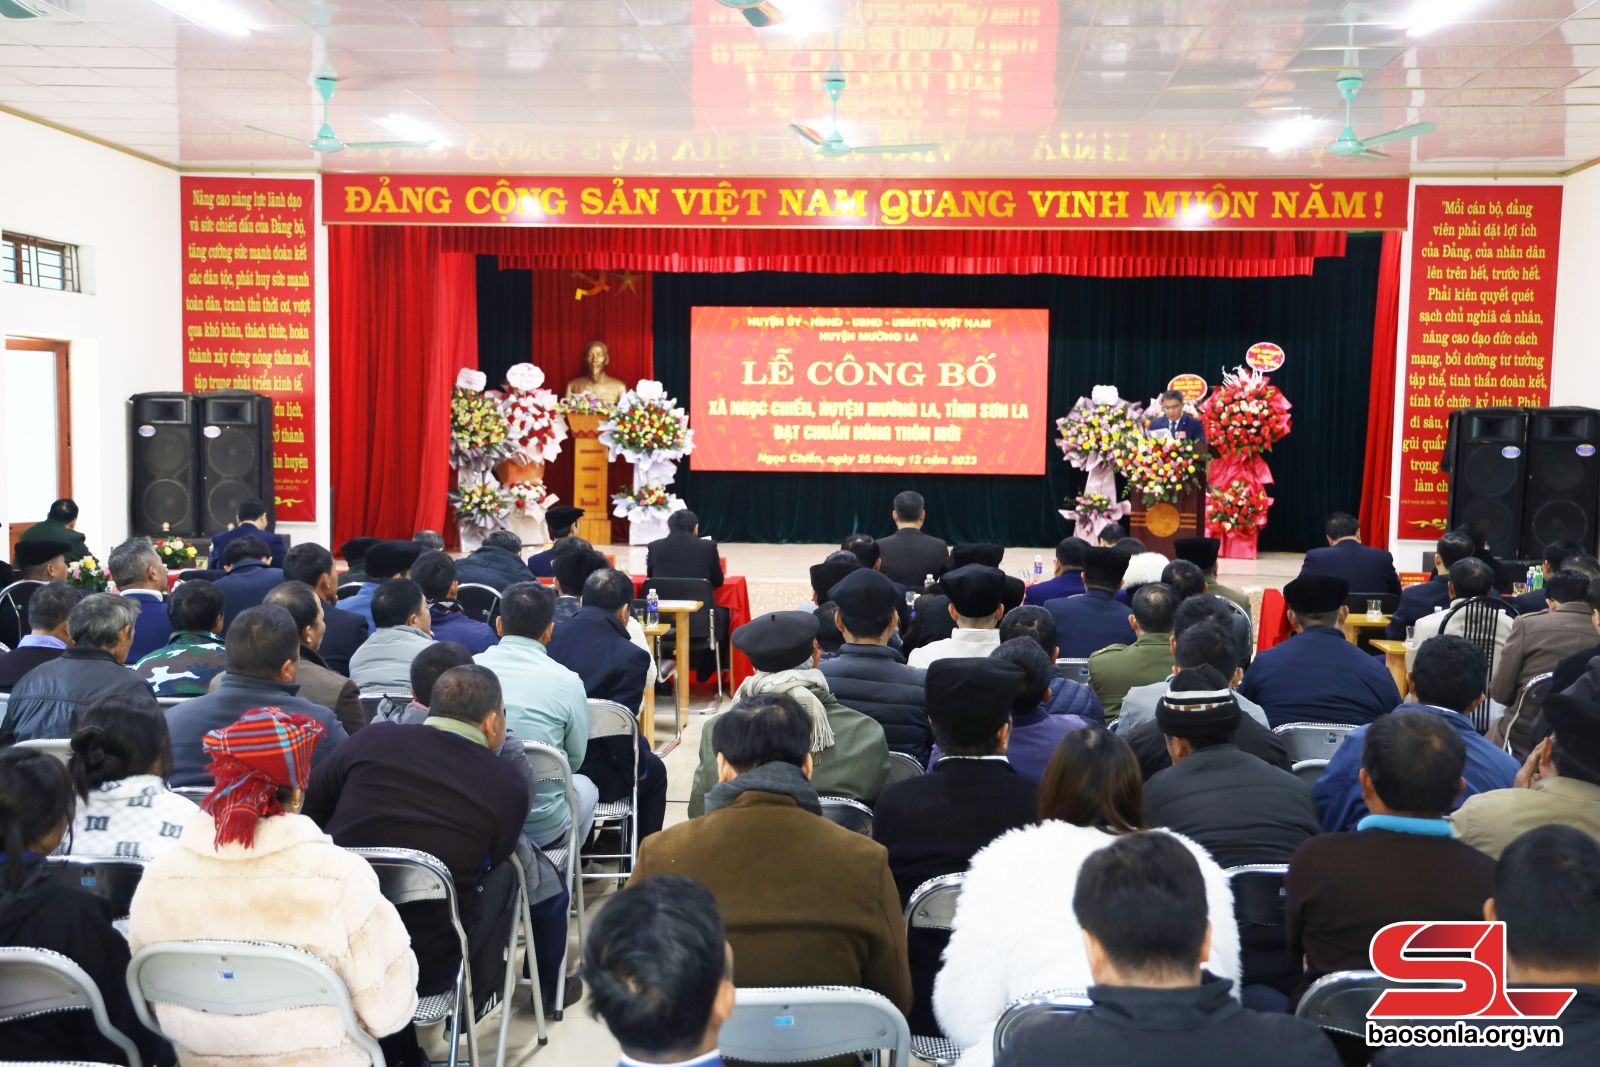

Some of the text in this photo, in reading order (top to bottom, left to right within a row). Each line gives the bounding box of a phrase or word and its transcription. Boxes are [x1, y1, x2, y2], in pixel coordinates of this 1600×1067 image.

[345, 176, 452, 213] ĐẢNG
[466, 180, 568, 223] CỘNG
[581, 176, 661, 215] SẢN
[671, 181, 767, 222] VIỆT
[779, 189, 869, 217] NAM
[879, 188, 1015, 225] QUANG
[1028, 191, 1129, 218] VINH
[1143, 184, 1258, 219] MUÔN
[1271, 183, 1366, 218] NĂM
[742, 348, 996, 387] LỄ CÔNG BỐ
[709, 397, 1028, 419] XÃ NGỌC CHIẾN, HUYỆN MƯỜNG LA, TỈNH SƠN LA
